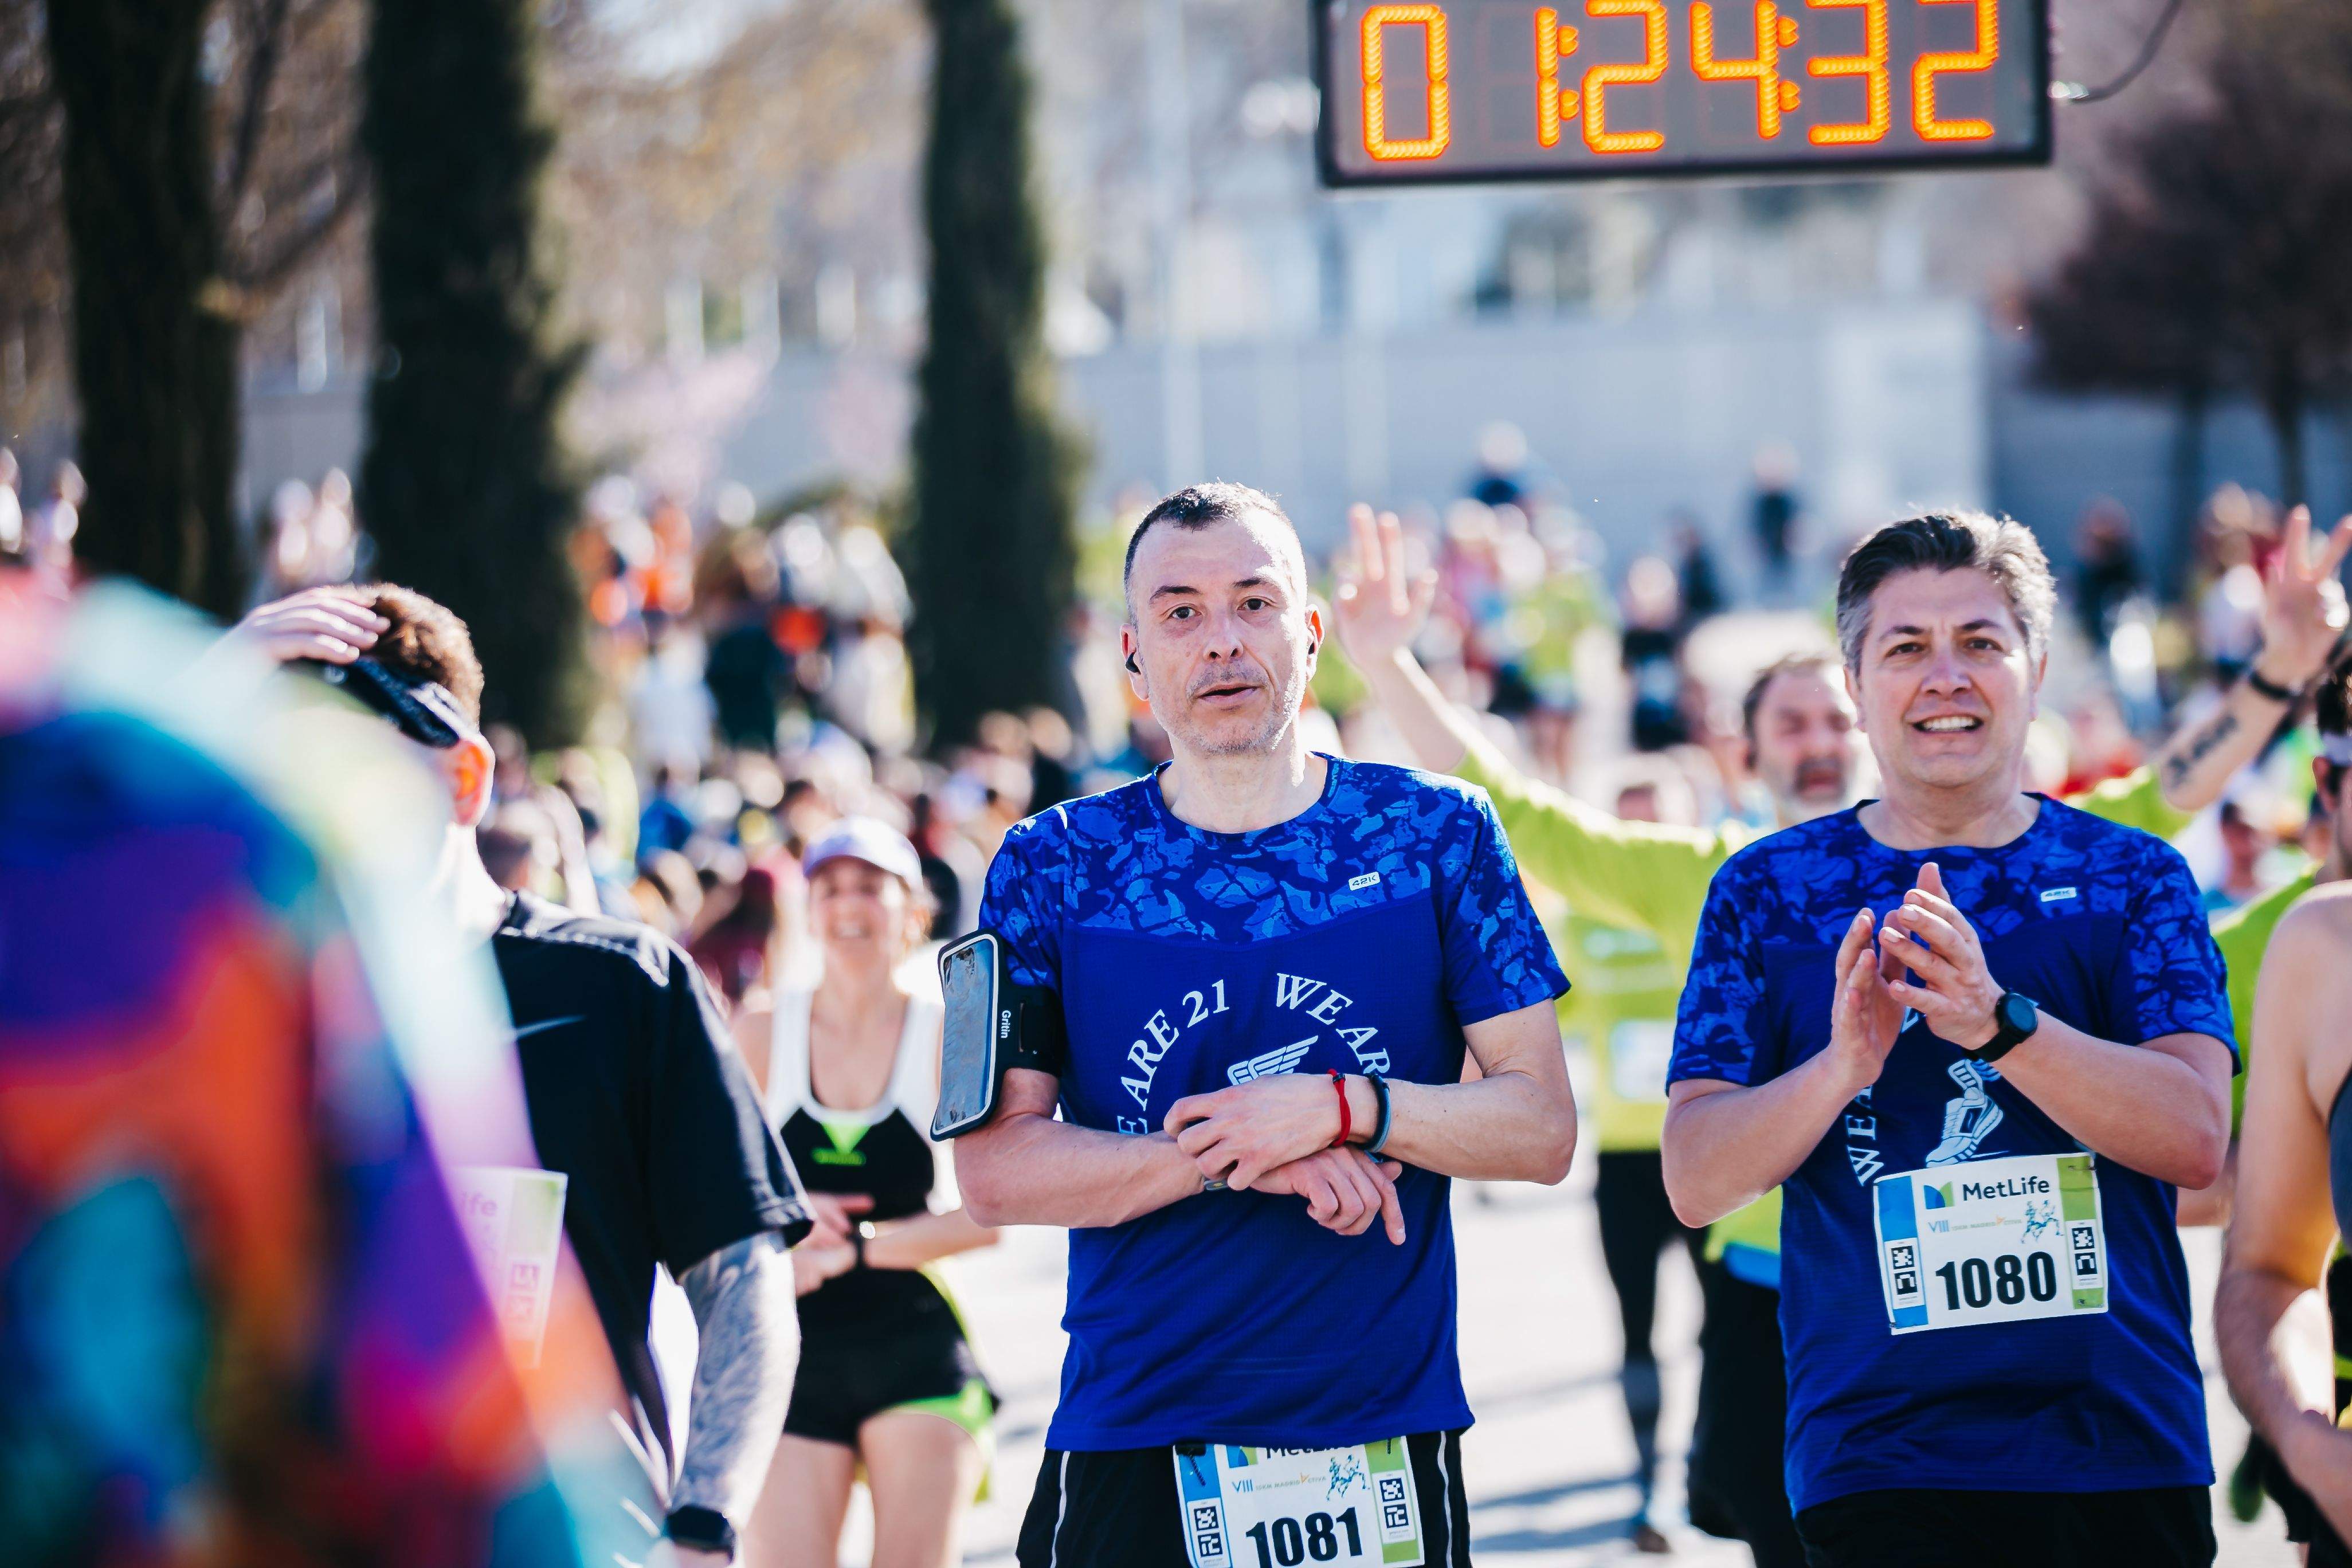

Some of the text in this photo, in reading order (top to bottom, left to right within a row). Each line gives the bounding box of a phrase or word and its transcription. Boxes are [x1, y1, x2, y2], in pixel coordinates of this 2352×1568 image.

[1001, 1010, 1012, 1038] Gritin
[1120, 1009, 1179, 1112] ARE
[1182, 979, 1230, 1028] 21
[1276, 973, 1354, 1025] WE
[1336, 1027, 1390, 1074] AR
[1845, 1115, 1884, 1187] WE
[1962, 1176, 2050, 1202] MetLife
[1928, 1220, 1950, 1233] VIII
[1935, 1251, 2057, 1311] 1080
[1232, 1479, 1253, 1493] VIII
[1245, 1506, 1363, 1568] 1081
